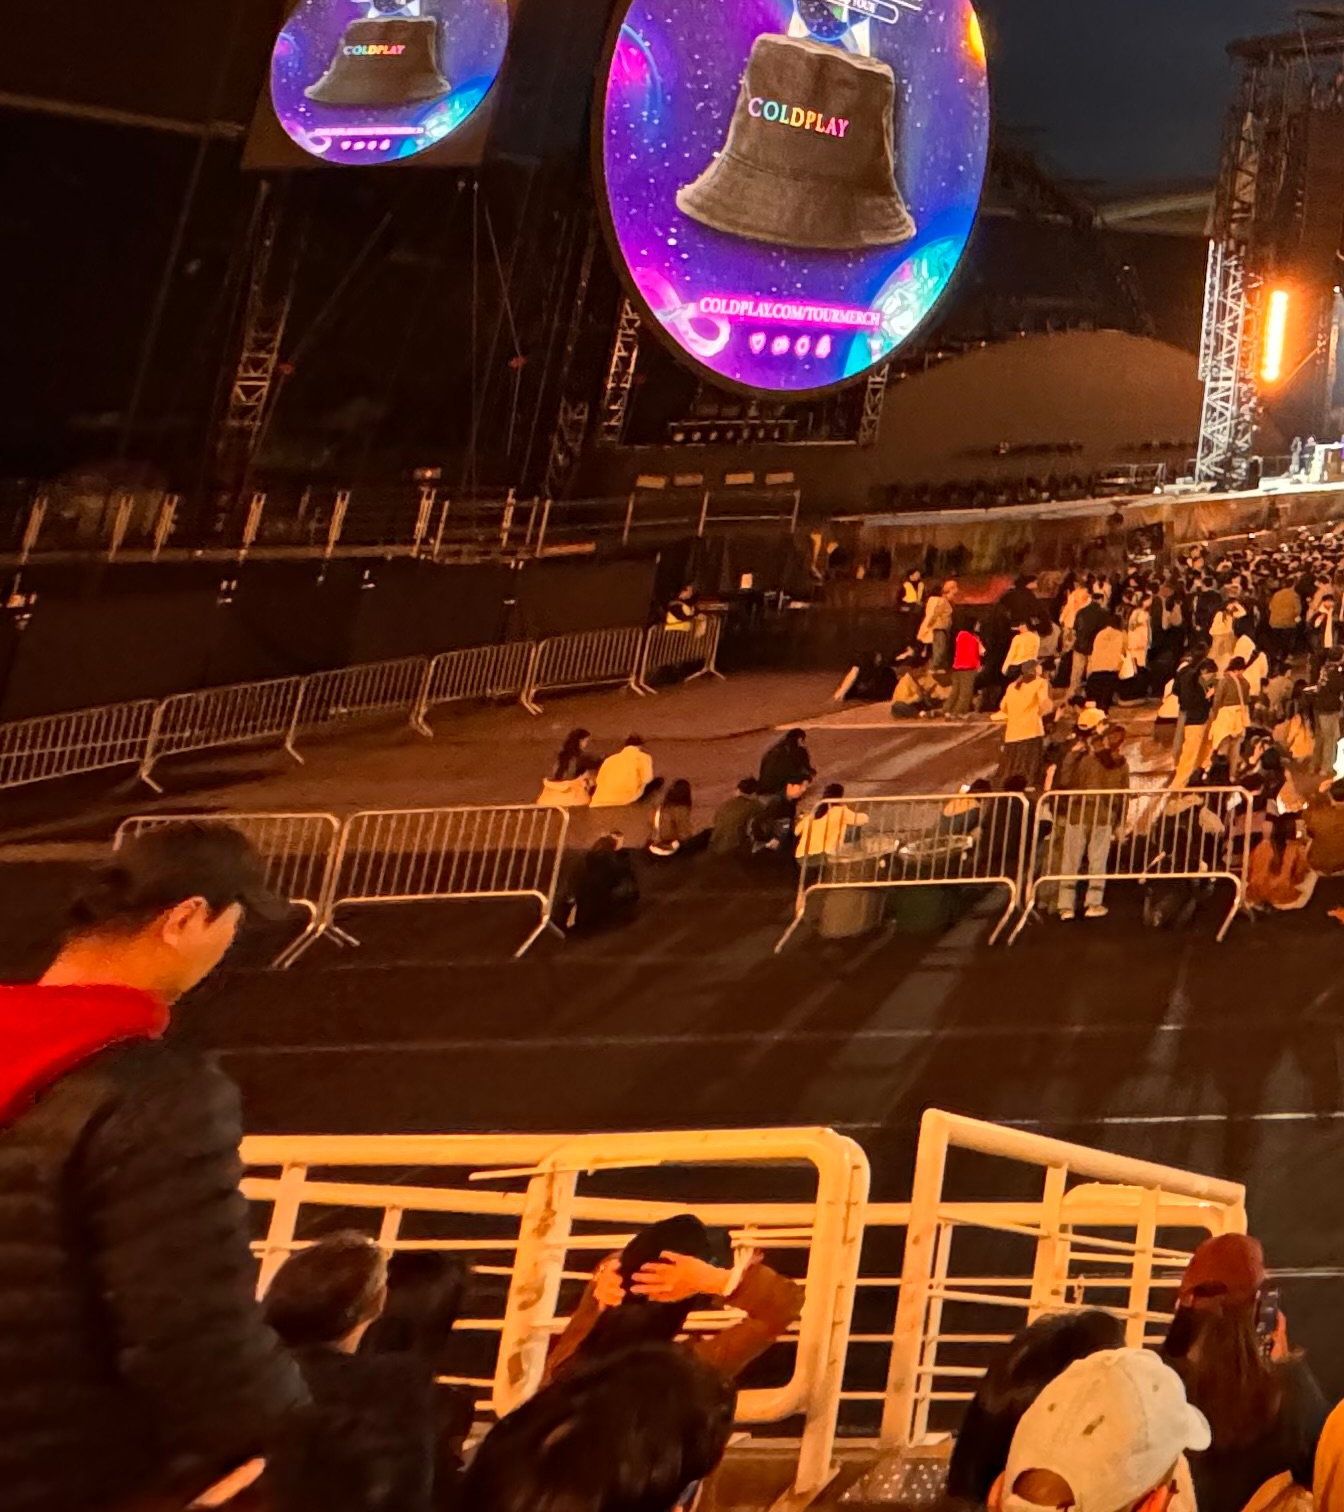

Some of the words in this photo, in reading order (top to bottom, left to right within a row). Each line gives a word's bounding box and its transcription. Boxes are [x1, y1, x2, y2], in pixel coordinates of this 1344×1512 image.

[343, 44, 406, 55] COLDPLAY
[748, 97, 849, 138] COLDPLAY
[700, 296, 881, 326] COLDPLAY.COM/TOURMERCH
